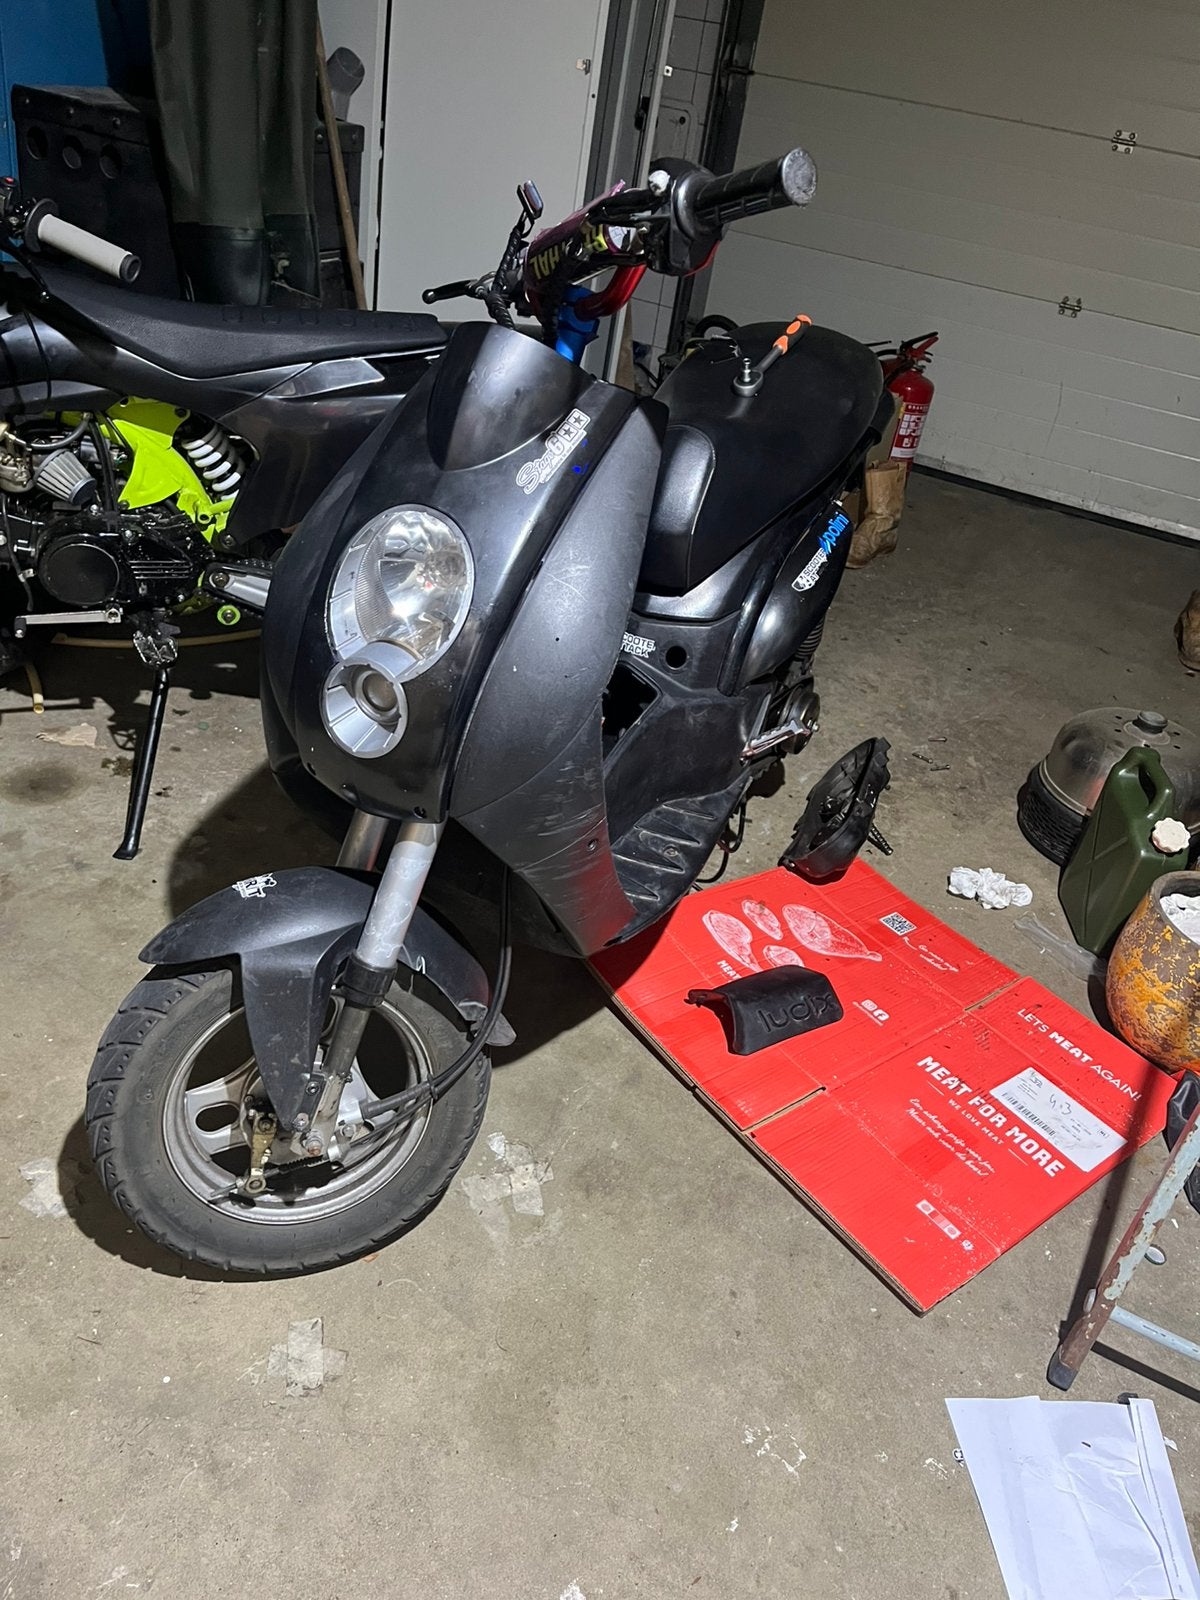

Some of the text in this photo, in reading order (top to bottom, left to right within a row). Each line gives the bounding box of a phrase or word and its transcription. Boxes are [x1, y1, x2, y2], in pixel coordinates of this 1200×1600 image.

[822, 511, 850, 547] polini
[757, 993, 832, 1033] ludix
[1017, 1008, 1142, 1101] LETS MEAT AGAIN!
[916, 1055, 972, 1096] MEAT
[967, 1095, 1007, 1128] FOR
[1005, 1126, 1066, 1177] MORE
[948, 1099, 1004, 1145] WE LOVE MEAT
